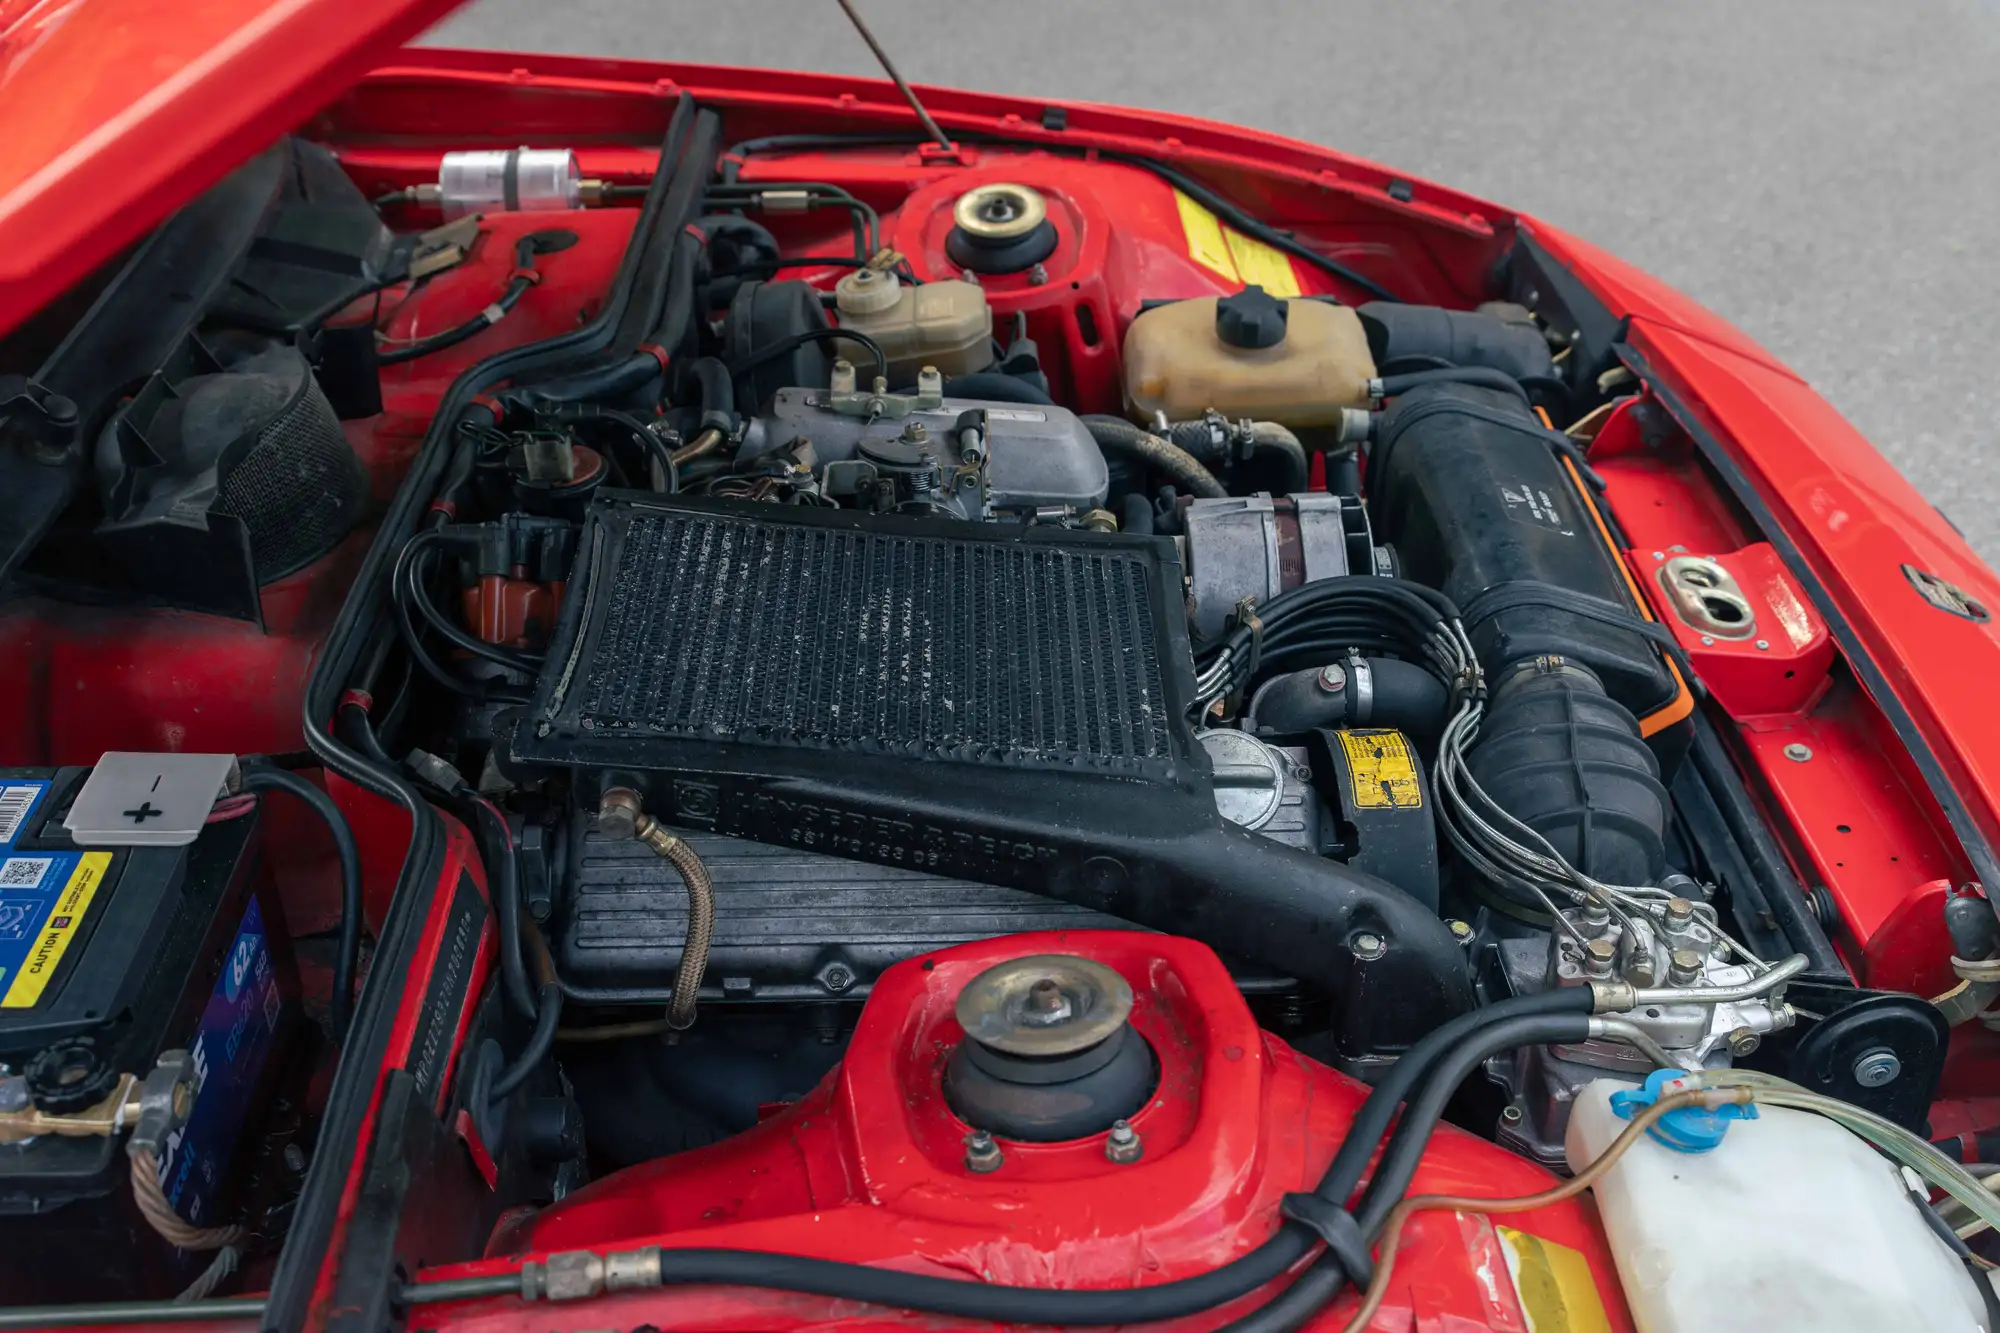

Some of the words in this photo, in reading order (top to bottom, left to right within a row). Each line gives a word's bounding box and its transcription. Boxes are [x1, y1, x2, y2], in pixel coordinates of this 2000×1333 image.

[30, 931, 60, 974] CAUTION
[233, 941, 250, 986] 62
[225, 989, 254, 1061] EB620
